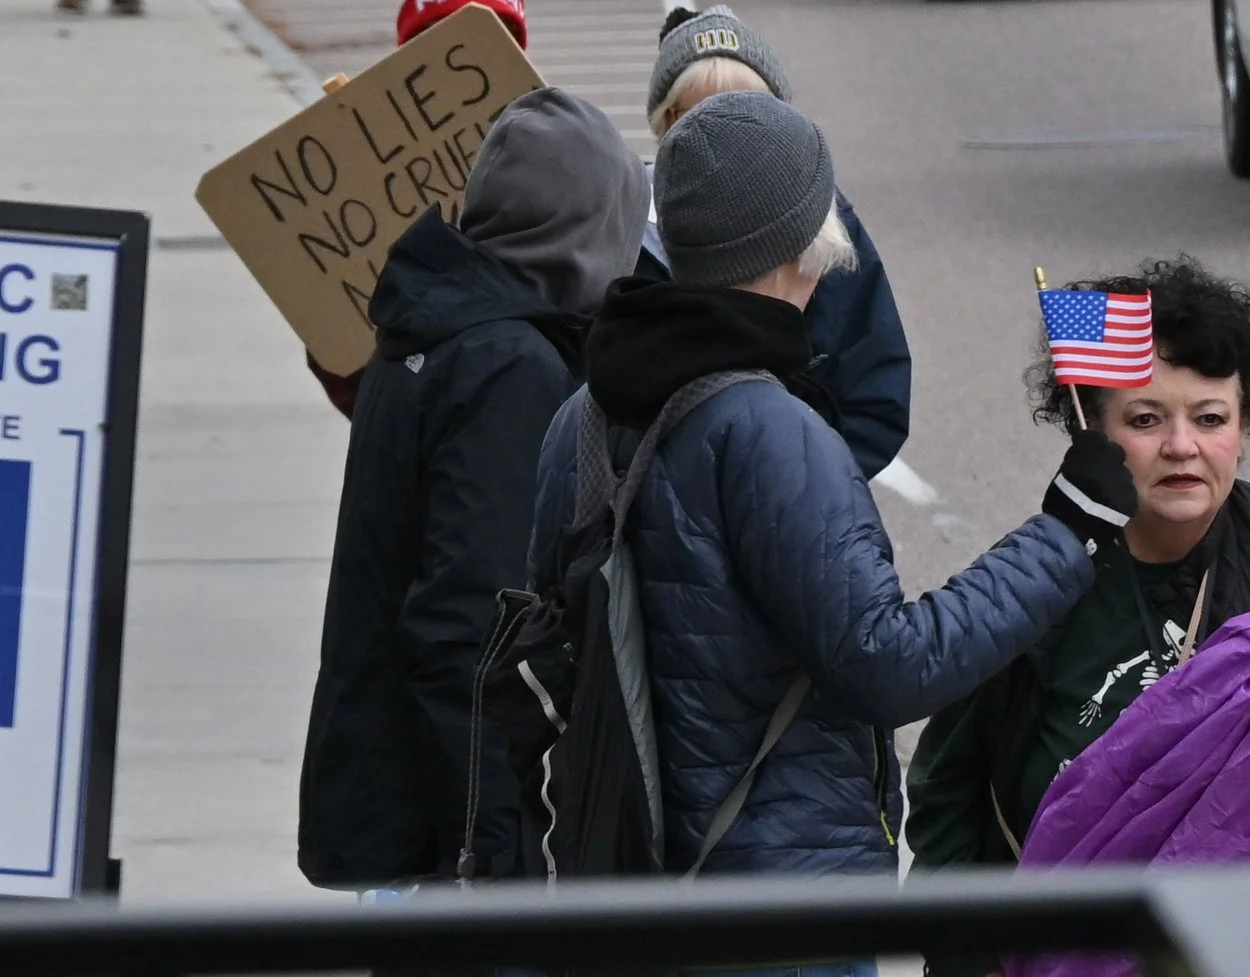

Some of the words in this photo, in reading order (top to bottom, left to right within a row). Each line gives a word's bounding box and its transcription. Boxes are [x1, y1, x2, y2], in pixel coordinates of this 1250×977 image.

[250, 135, 337, 223] NO
[352, 44, 490, 165] LIES
[298, 199, 377, 273] NO
[384, 104, 507, 218] CRUE
